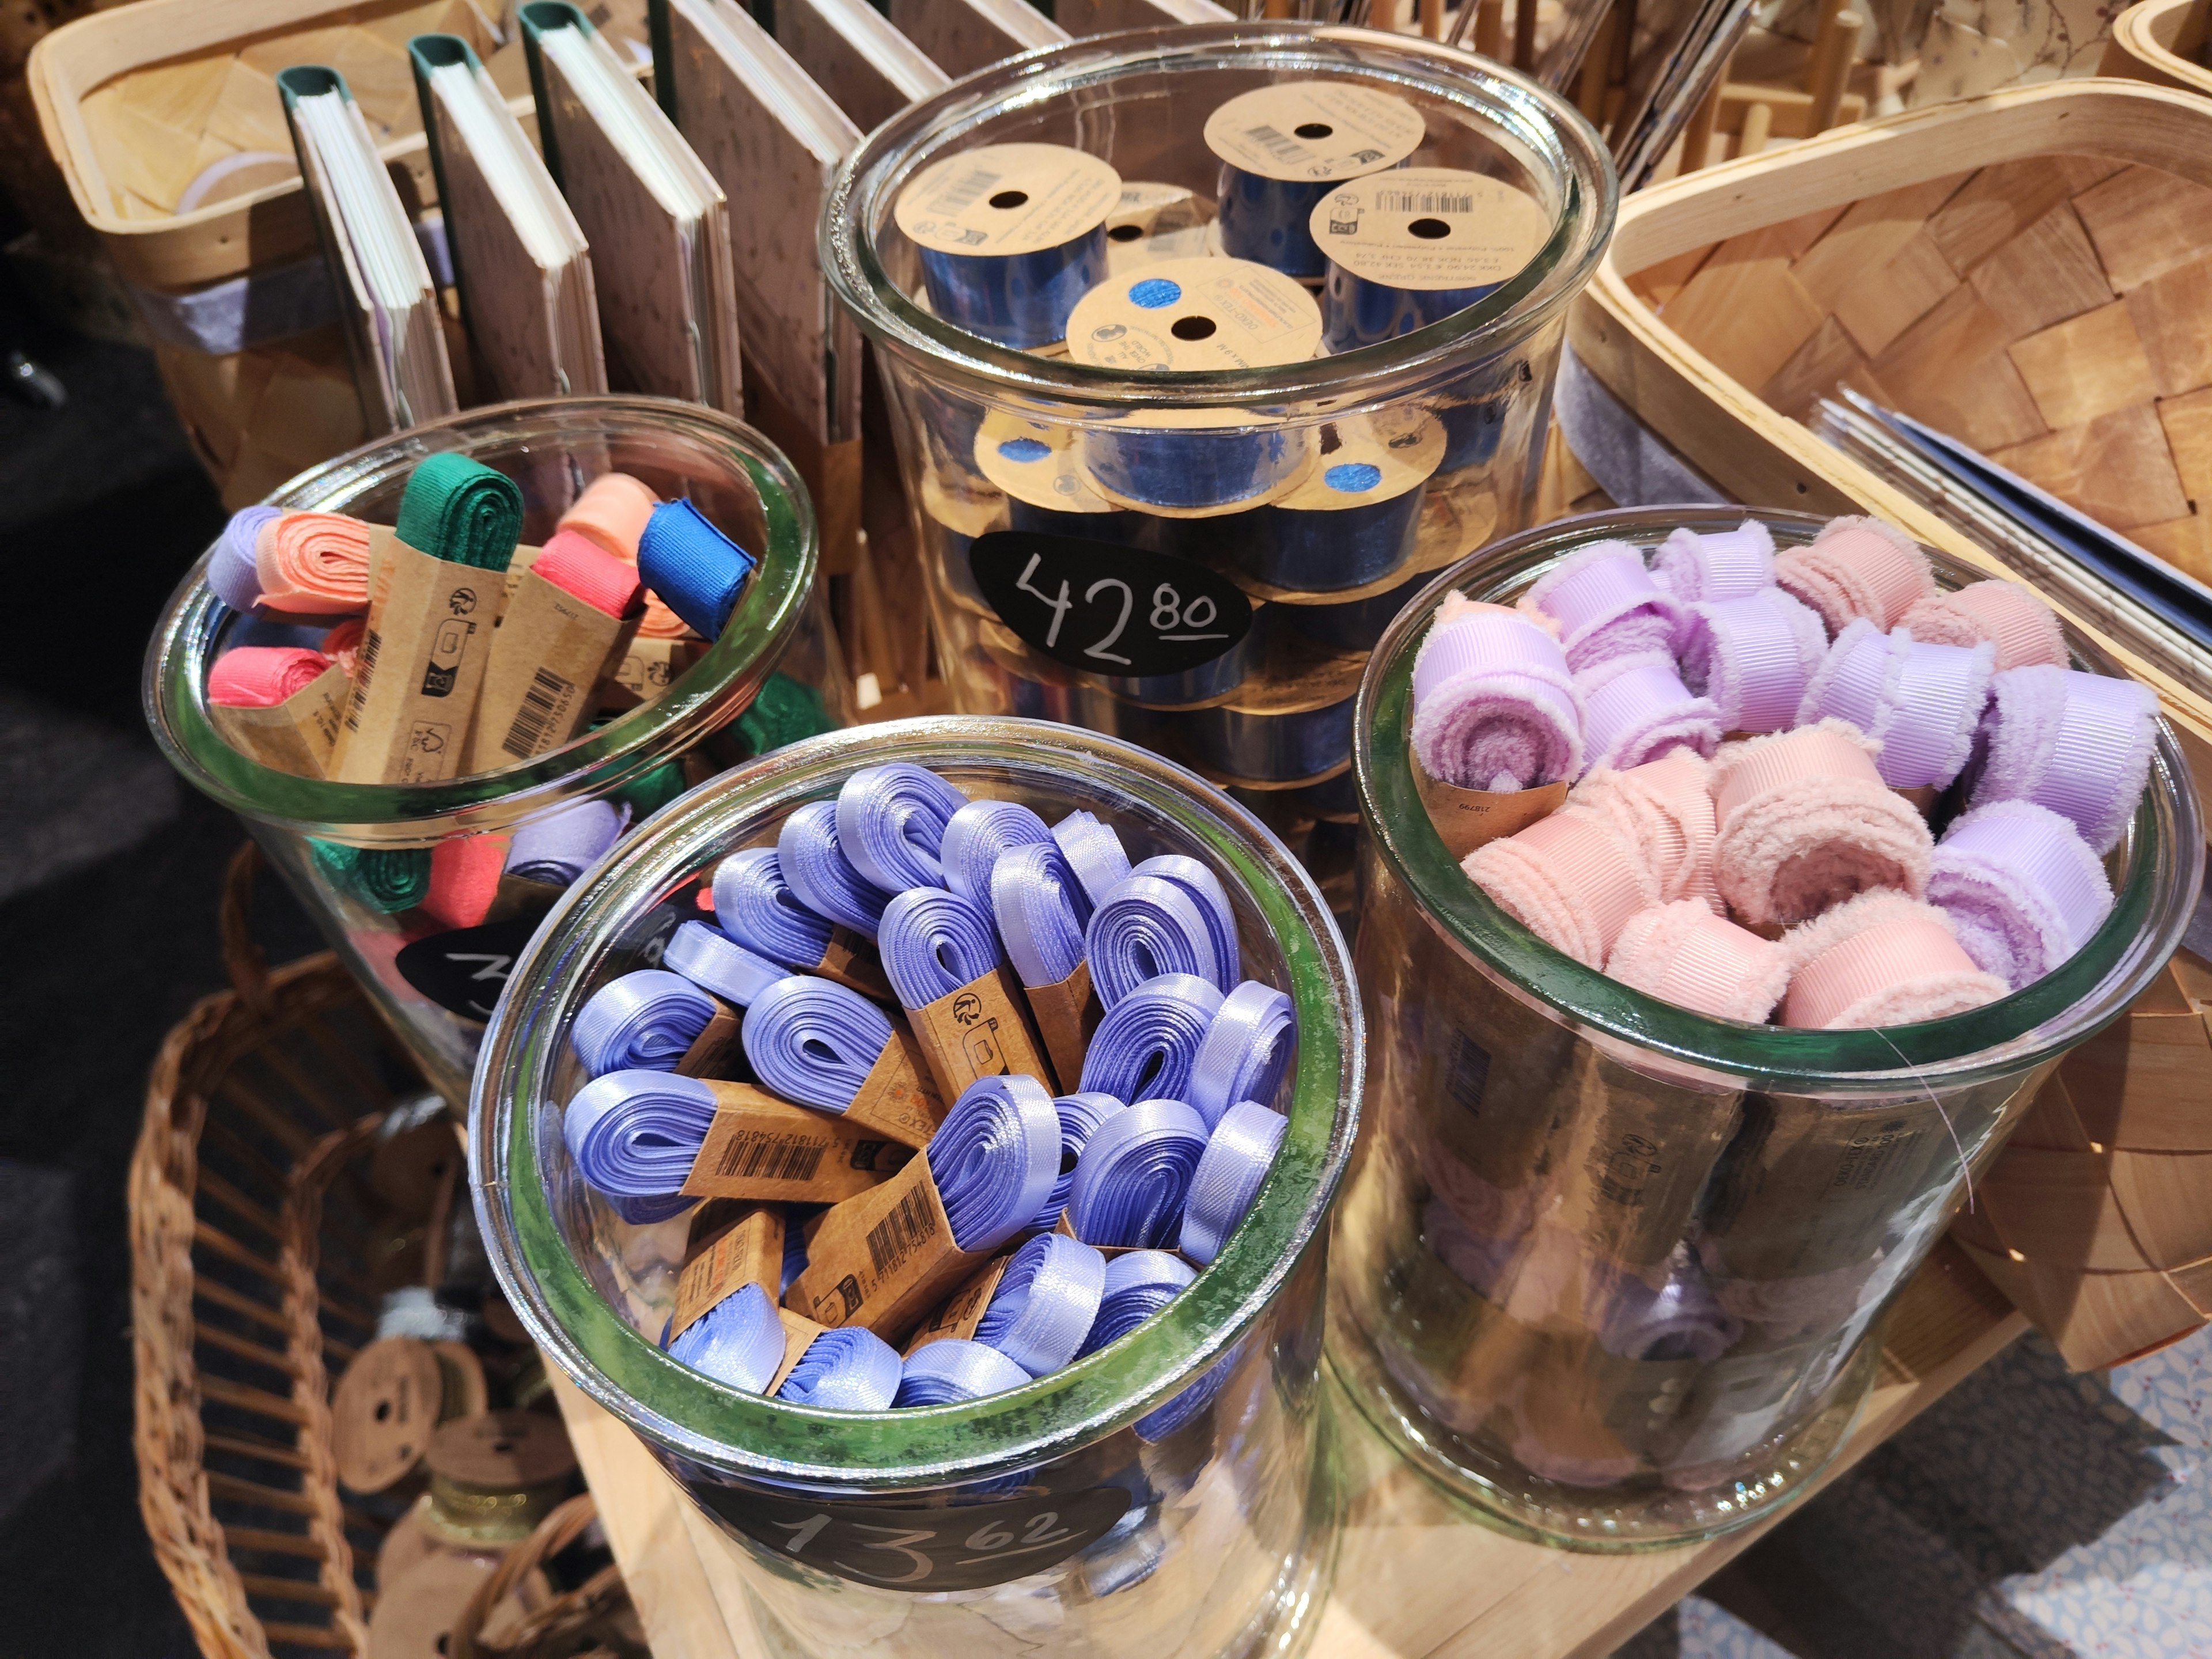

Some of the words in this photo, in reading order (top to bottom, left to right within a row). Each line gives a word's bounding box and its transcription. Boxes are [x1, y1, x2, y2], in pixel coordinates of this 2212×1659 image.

[1118, 340, 1131, 351] THE
[1131, 340, 1152, 358] WORLD
[1118, 351, 1130, 360] ALL
[1129, 350, 1146, 364] OVER
[1016, 552, 1133, 666] 42
[1149, 582, 1218, 630] 80
[1459, 803, 1491, 813] 218799
[736, 1130, 785, 1145] 754818
[878, 1250, 907, 1284] 711812
[904, 1223, 935, 1253] 754818
[771, 1513, 938, 1584] 13
[964, 1512, 1071, 1551] 62
